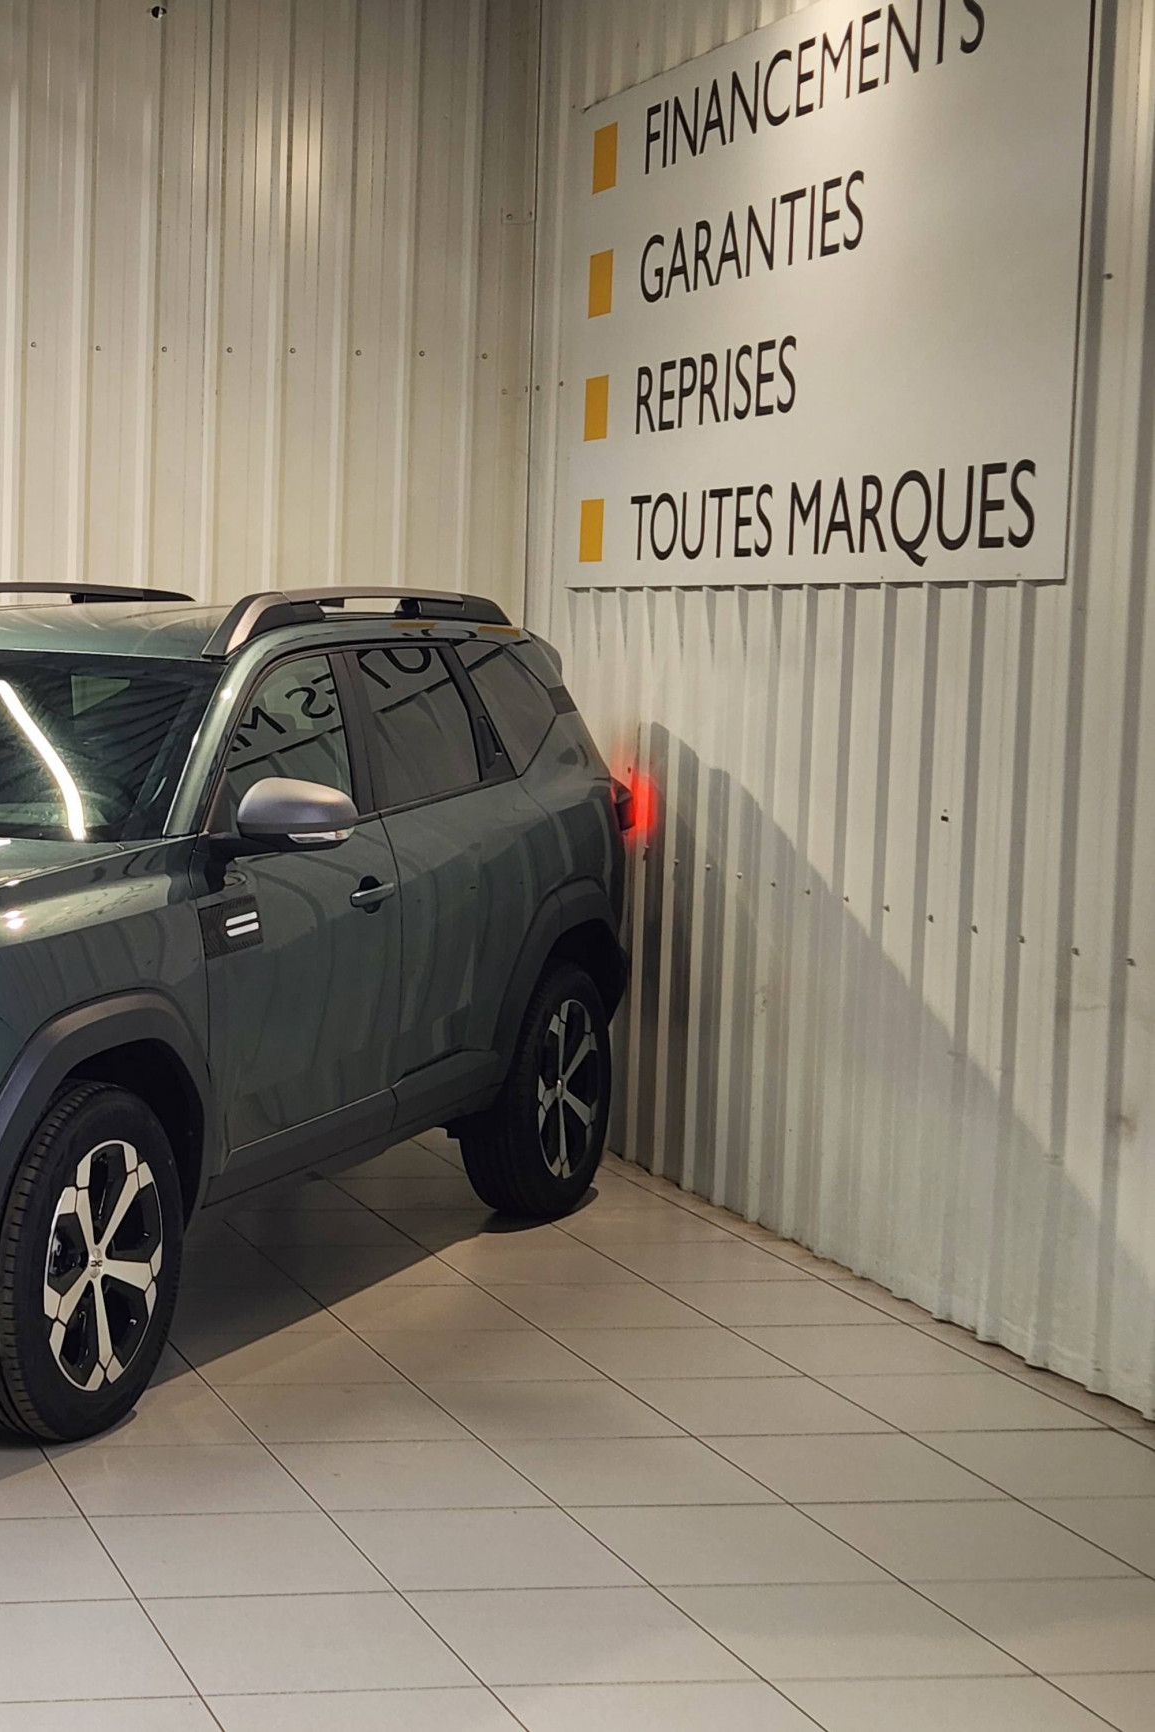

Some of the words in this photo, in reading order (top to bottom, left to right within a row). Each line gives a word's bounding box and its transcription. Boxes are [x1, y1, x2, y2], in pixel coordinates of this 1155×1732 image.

[640, 170, 865, 303] GARANTIES
[635, 335, 797, 435] REPRISES
[630, 483, 774, 561] TOUTES
[787, 458, 1037, 568] MARQUES
